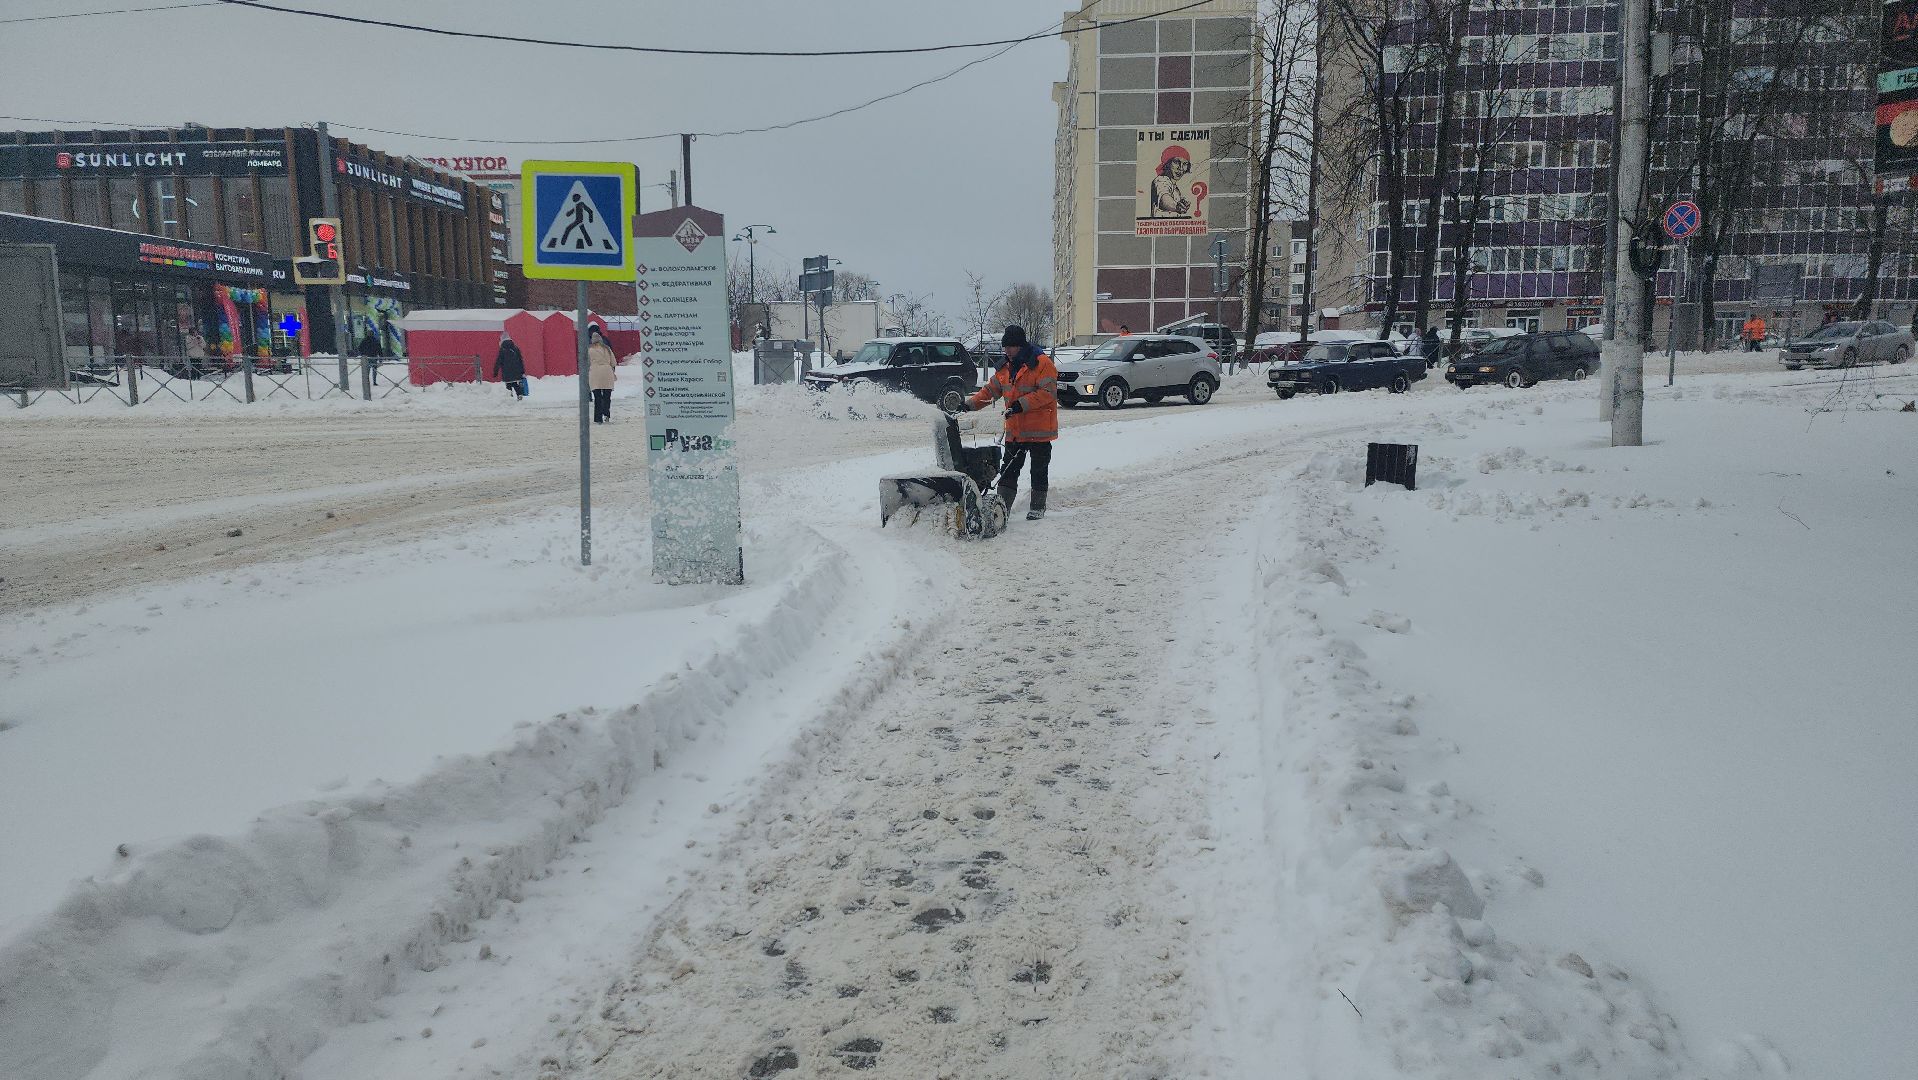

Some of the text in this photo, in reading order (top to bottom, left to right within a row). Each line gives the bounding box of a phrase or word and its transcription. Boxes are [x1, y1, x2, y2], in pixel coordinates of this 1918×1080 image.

[1138, 129, 1210, 141] А ТЫ СДЕЛАЛ
[75, 152, 186, 167] SUNLIGHT
[454, 157, 506, 170] ХУТОР
[346, 161, 402, 188] SUNLIGHT
[214, 252, 250, 264] КОСМЕТИКА
[666, 428, 712, 453] Руза
